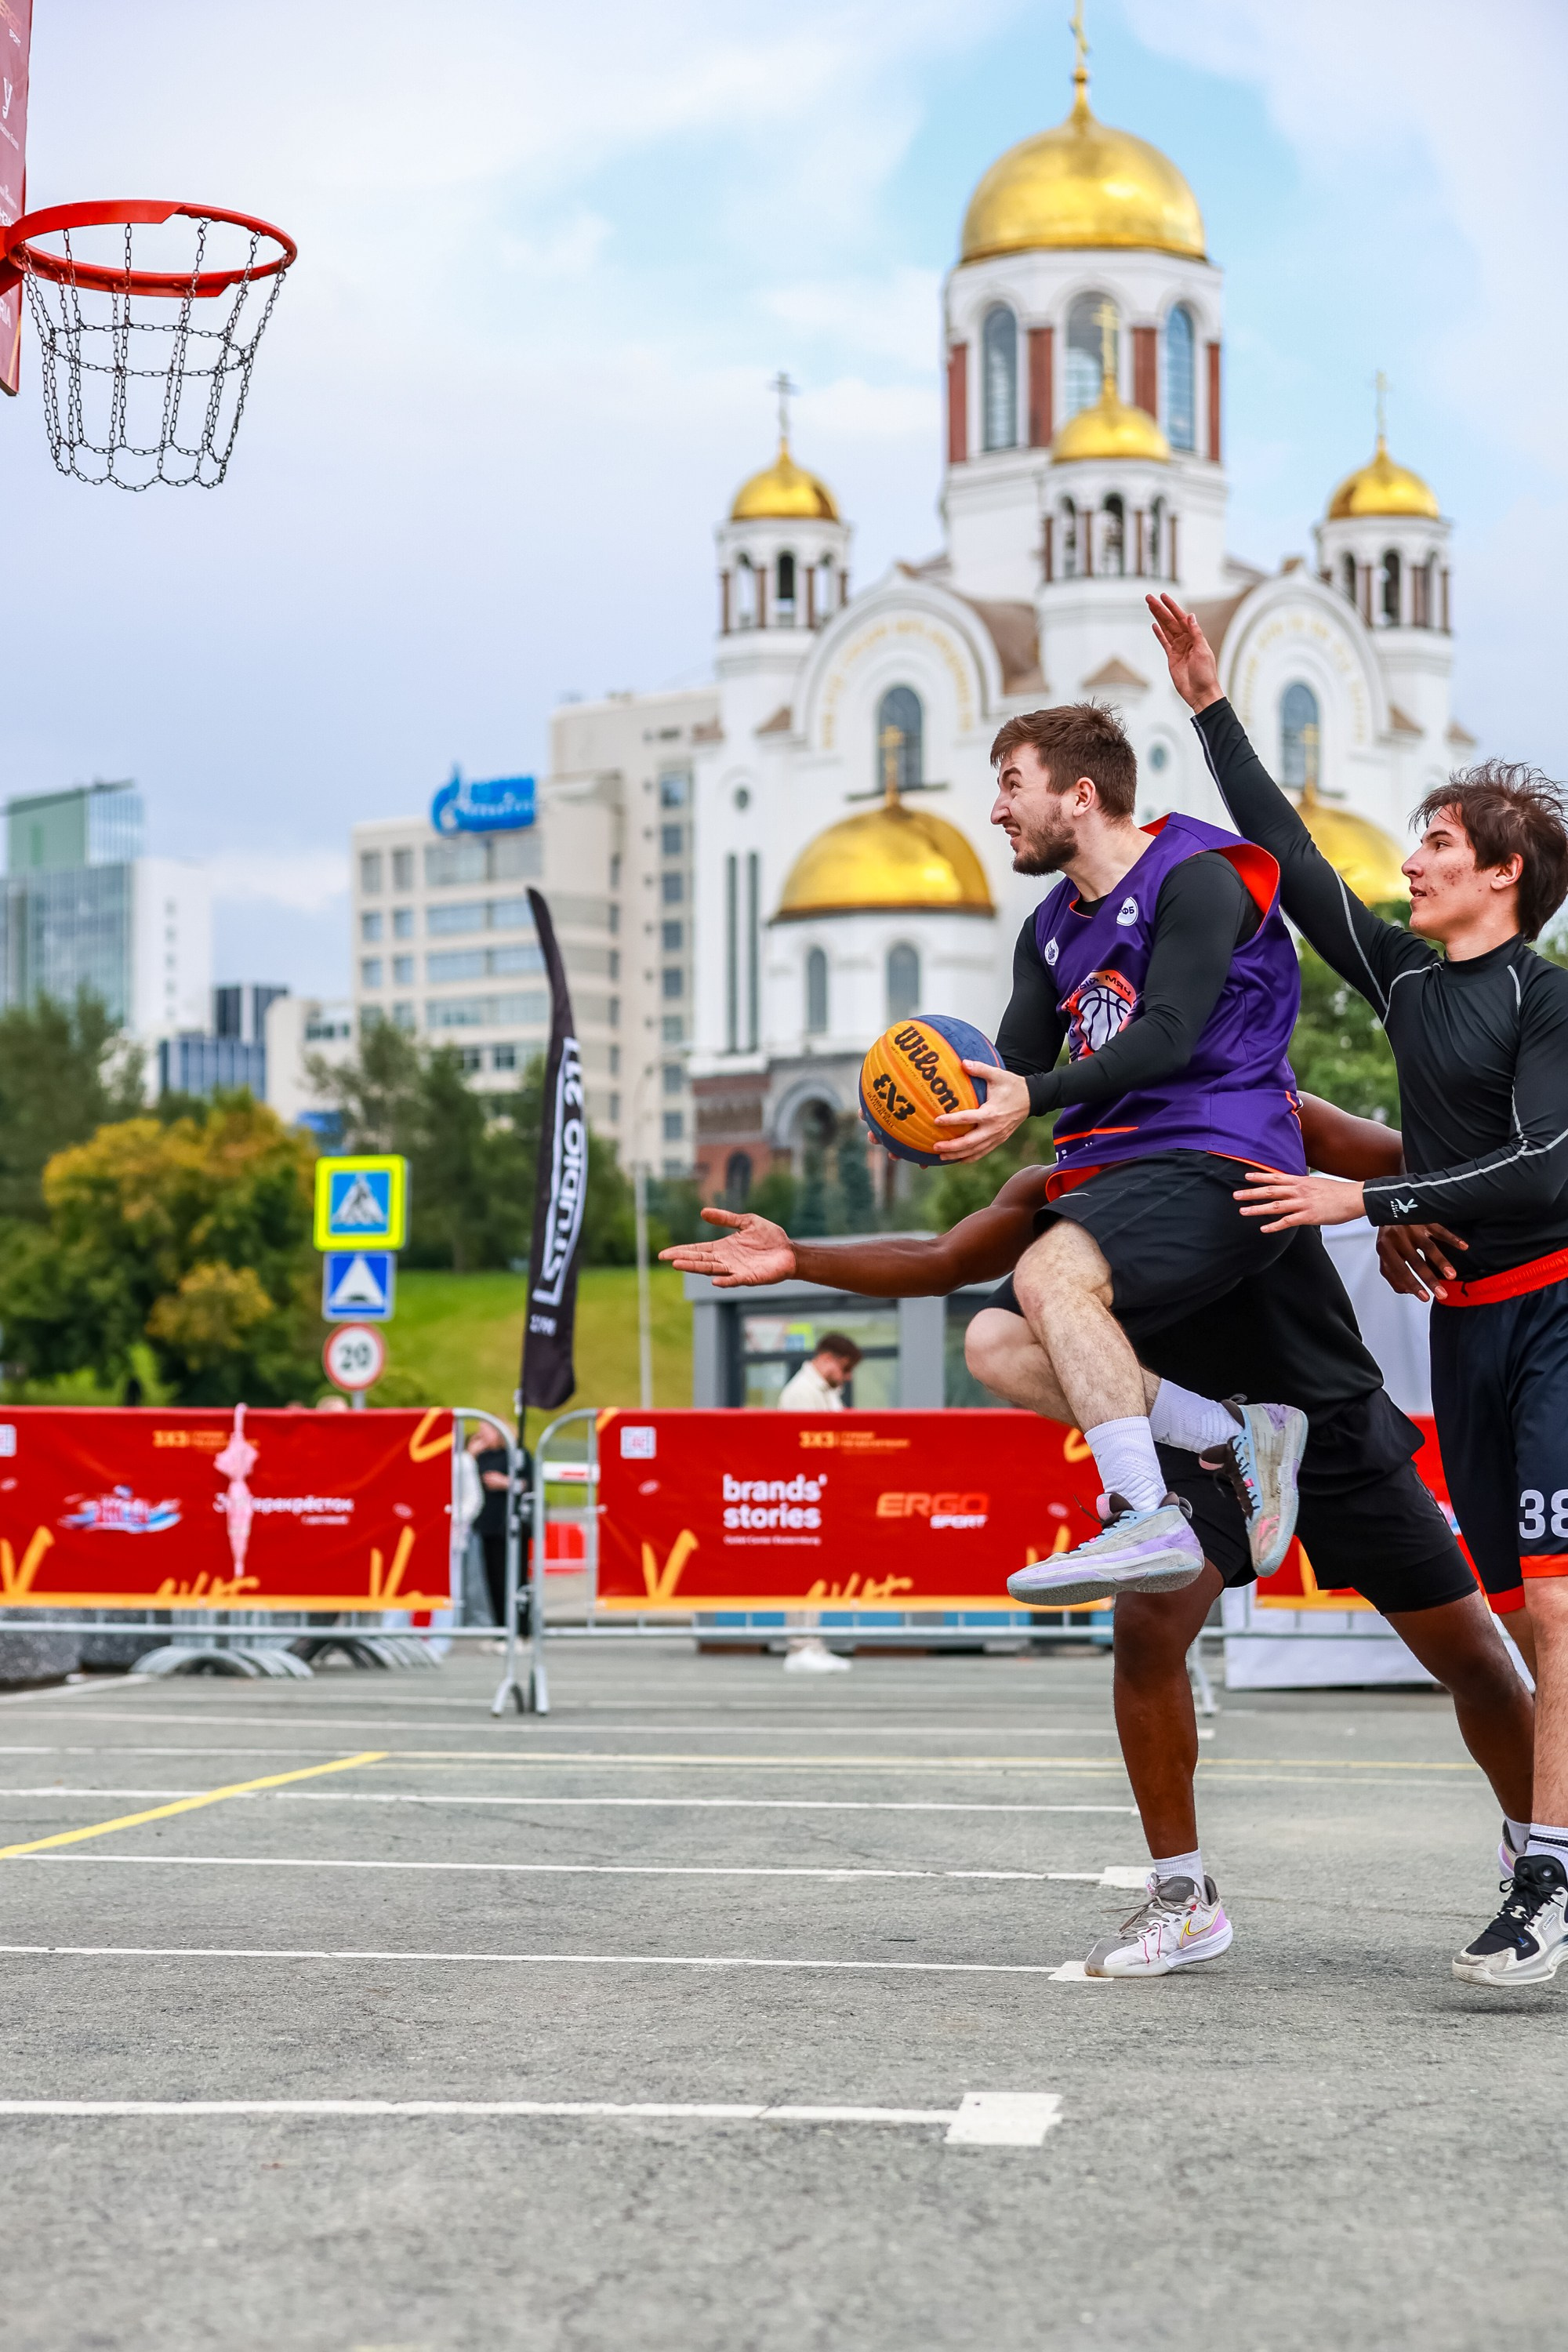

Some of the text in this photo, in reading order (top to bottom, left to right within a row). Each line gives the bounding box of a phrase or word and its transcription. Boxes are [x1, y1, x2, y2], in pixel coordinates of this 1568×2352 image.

[1119, 906, 1135, 916] ФБ
[895, 1025, 960, 1114] Wilson
[543, 1118, 583, 1282] STUDIO
[339, 1342, 372, 1370] 20
[723, 1473, 828, 1502] brands'
[723, 1502, 822, 1529] stories
[876, 1492, 989, 1518] ERGO
[1519, 1488, 1568, 1539] 38
[930, 1515, 987, 1529] SPORT
